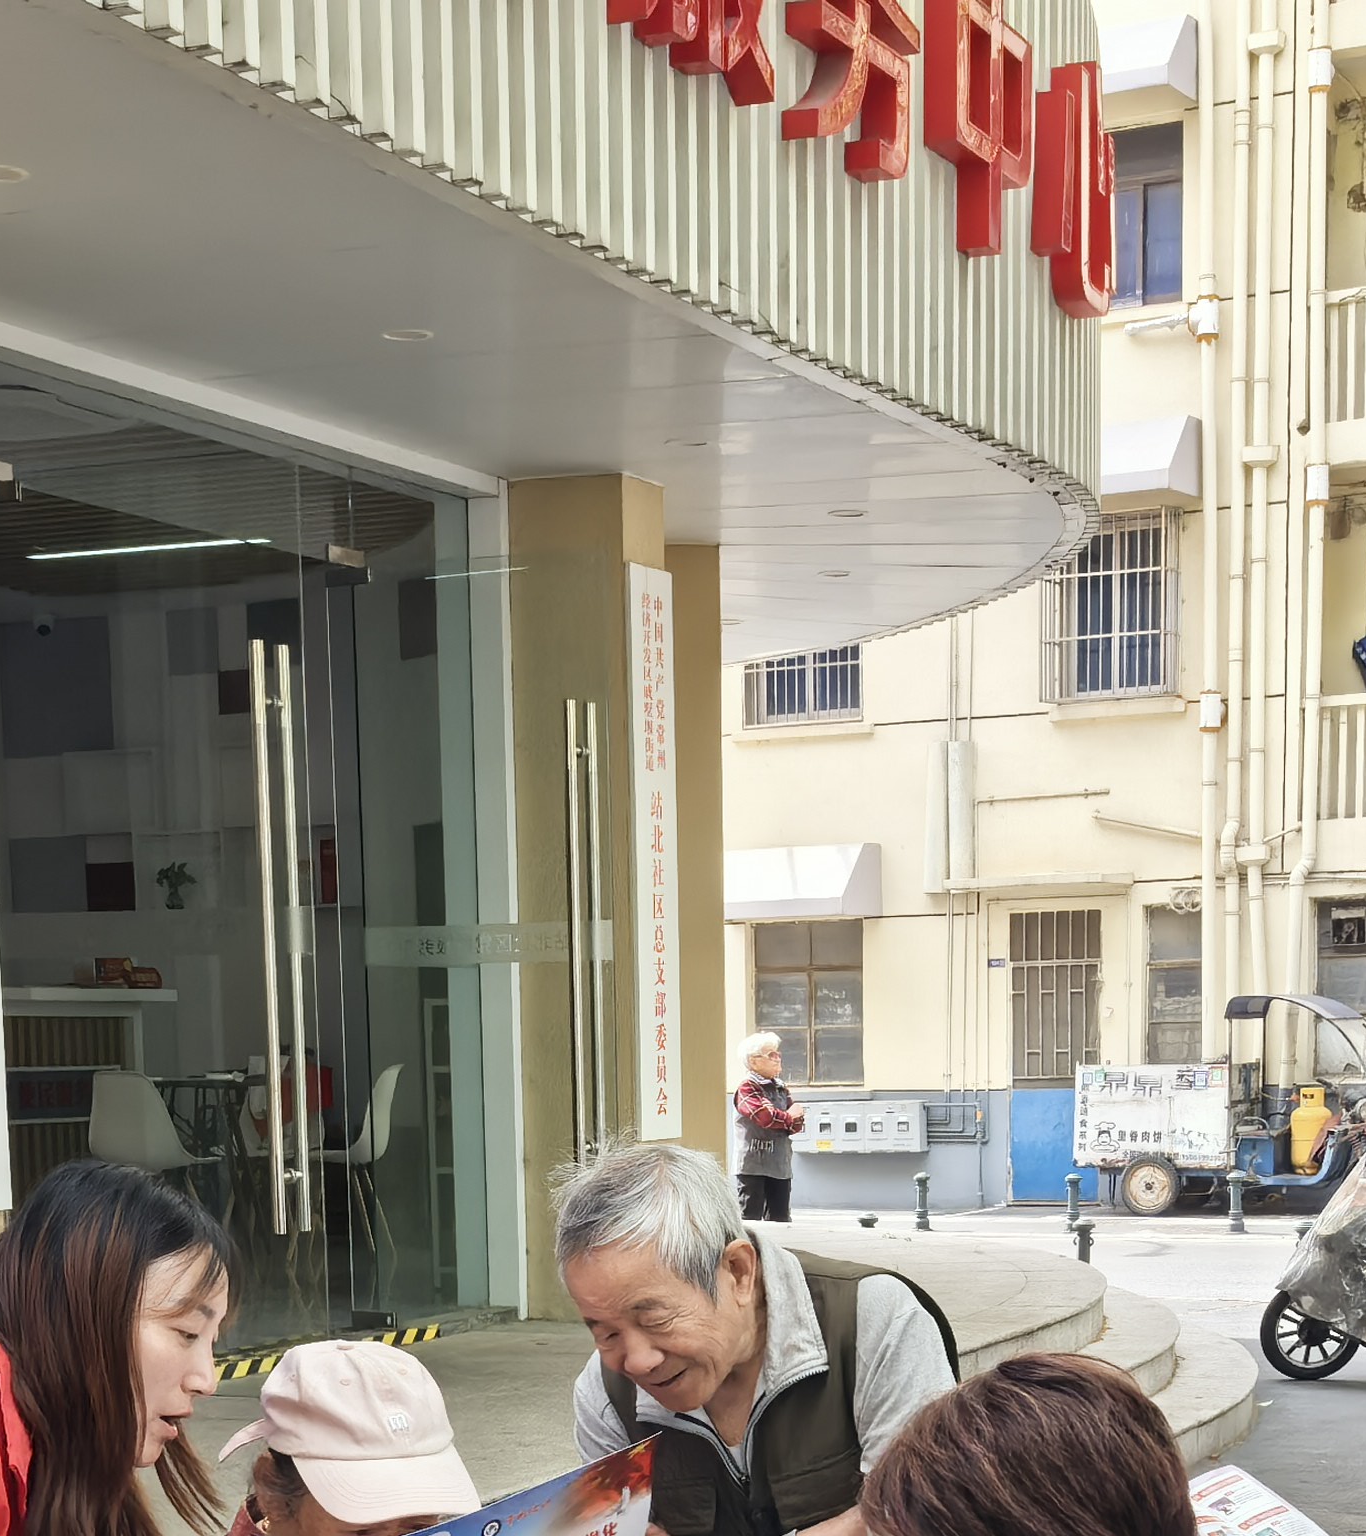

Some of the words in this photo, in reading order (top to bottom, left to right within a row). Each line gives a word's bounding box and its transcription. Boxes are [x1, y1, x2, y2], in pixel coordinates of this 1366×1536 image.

[653, 595, 667, 771] 中国共产党常州
[650, 791, 668, 1116] 站北社区总支部委员会
